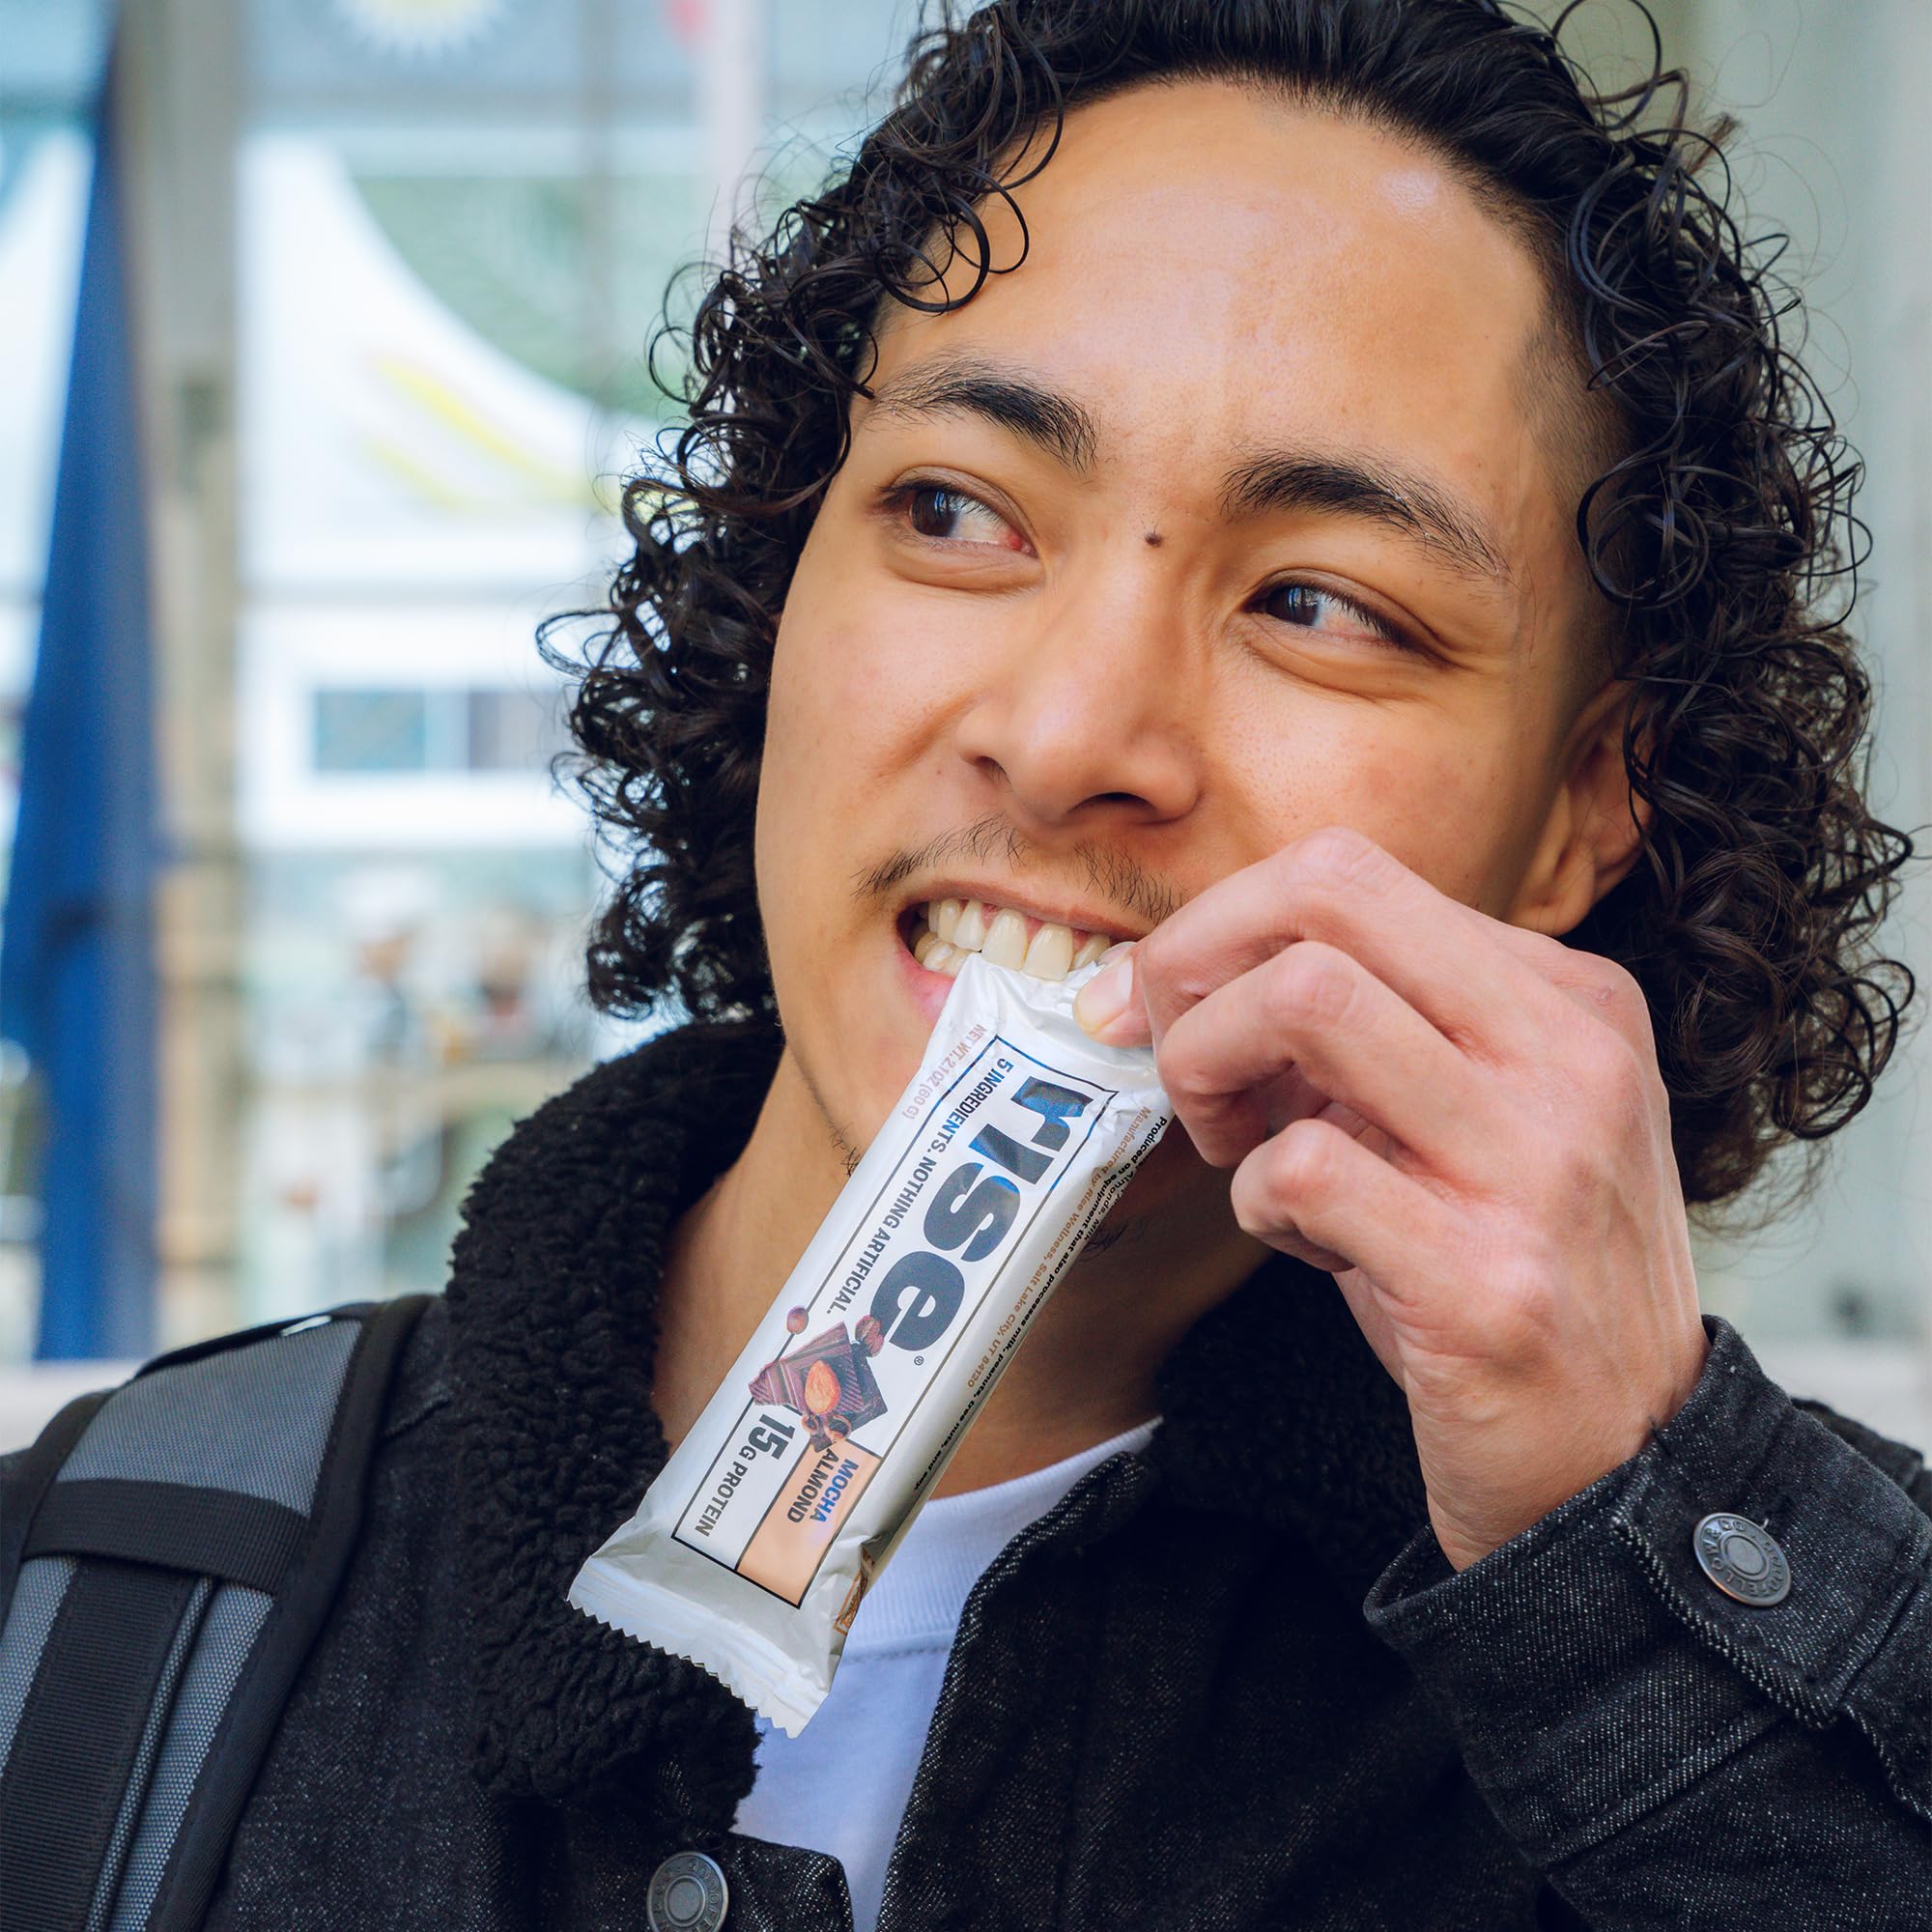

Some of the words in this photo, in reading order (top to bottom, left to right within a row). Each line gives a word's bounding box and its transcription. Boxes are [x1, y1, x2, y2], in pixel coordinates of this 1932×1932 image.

[964, 1024, 987, 1044] NET
[996, 1058, 1014, 1073] 5
[926, 1067, 1005, 1153] INGREDIENTS.
[1100, 1107, 1151, 1174] Manufactured
[1131, 1117, 1167, 1163] Produced
[1091, 1172, 1102, 1187] by
[1117, 1162, 1130, 1175] on
[881, 1155, 937, 1230] NOTHING
[1076, 1187, 1094, 1211] Rise
[1081, 1174, 1118, 1230] equipment
[869, 1076, 1094, 1351] rise
[1042, 1212, 1080, 1261] Wellness,
[1066, 1229, 1084, 1252] that
[825, 1227, 891, 1315] ARTIFICIAL.
[1029, 1263, 1047, 1287] Salt
[1053, 1251, 1069, 1275] also
[1013, 1286, 1033, 1313] Lake
[1019, 1273, 1055, 1327] processes
[996, 1314, 1015, 1337] City,
[1002, 1326, 1021, 1352] milk,
[987, 1339, 1001, 1357] UT
[966, 1354, 989, 1388] 84120
[972, 1353, 1004, 1398] peanuts,
[958, 1400, 975, 1422] tree
[926, 1450, 942, 1472] and
[694, 1461, 748, 1538] PROTEIN
[786, 1447, 839, 1523] ALMOND
[809, 1459, 859, 1522] MOCHA
